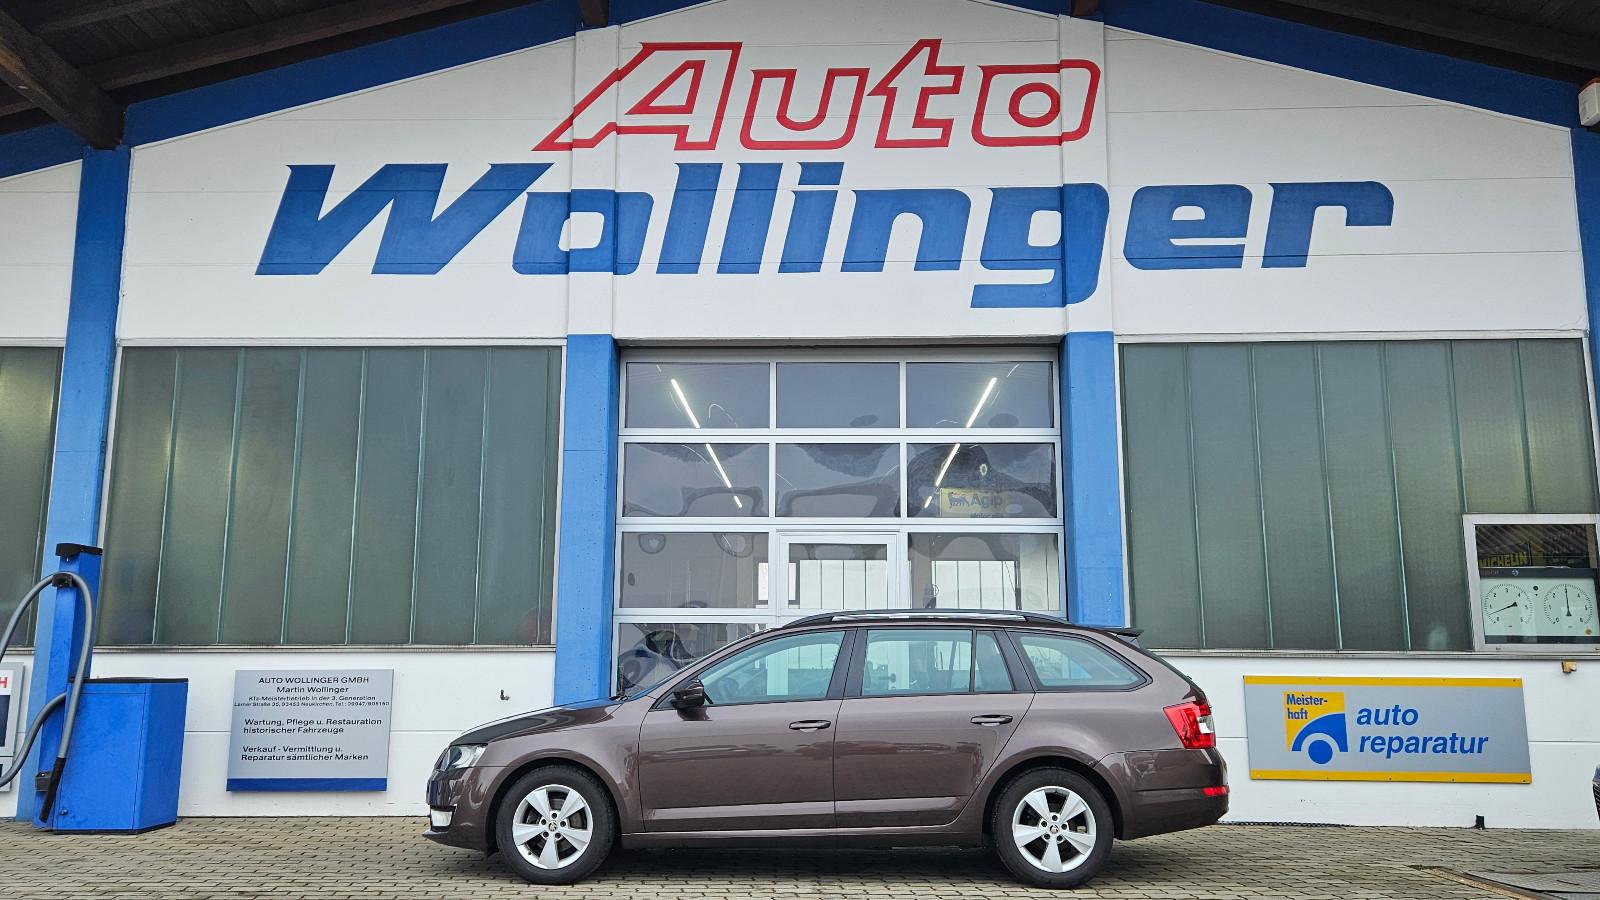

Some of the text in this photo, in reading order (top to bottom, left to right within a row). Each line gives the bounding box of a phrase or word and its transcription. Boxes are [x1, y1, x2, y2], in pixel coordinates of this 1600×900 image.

[532, 38, 1101, 151] Auto
[255, 162, 1394, 308] Wollinger
[971, 494, 1003, 509] Agip
[1478, 551, 1528, 567] MICHELIN
[307, 686, 349, 694] Wollinger
[1286, 693, 1328, 706] Meister-
[1287, 708, 1308, 721] haft
[1356, 704, 1419, 726] auto
[244, 719, 284, 727] Wartung,
[286, 718, 314, 727] Pflege
[298, 727, 344, 735] Fahrzeuge
[282, 746, 333, 754] Vermittlung
[1359, 732, 1489, 759] reparatur
[241, 754, 284, 762] Reparatur
